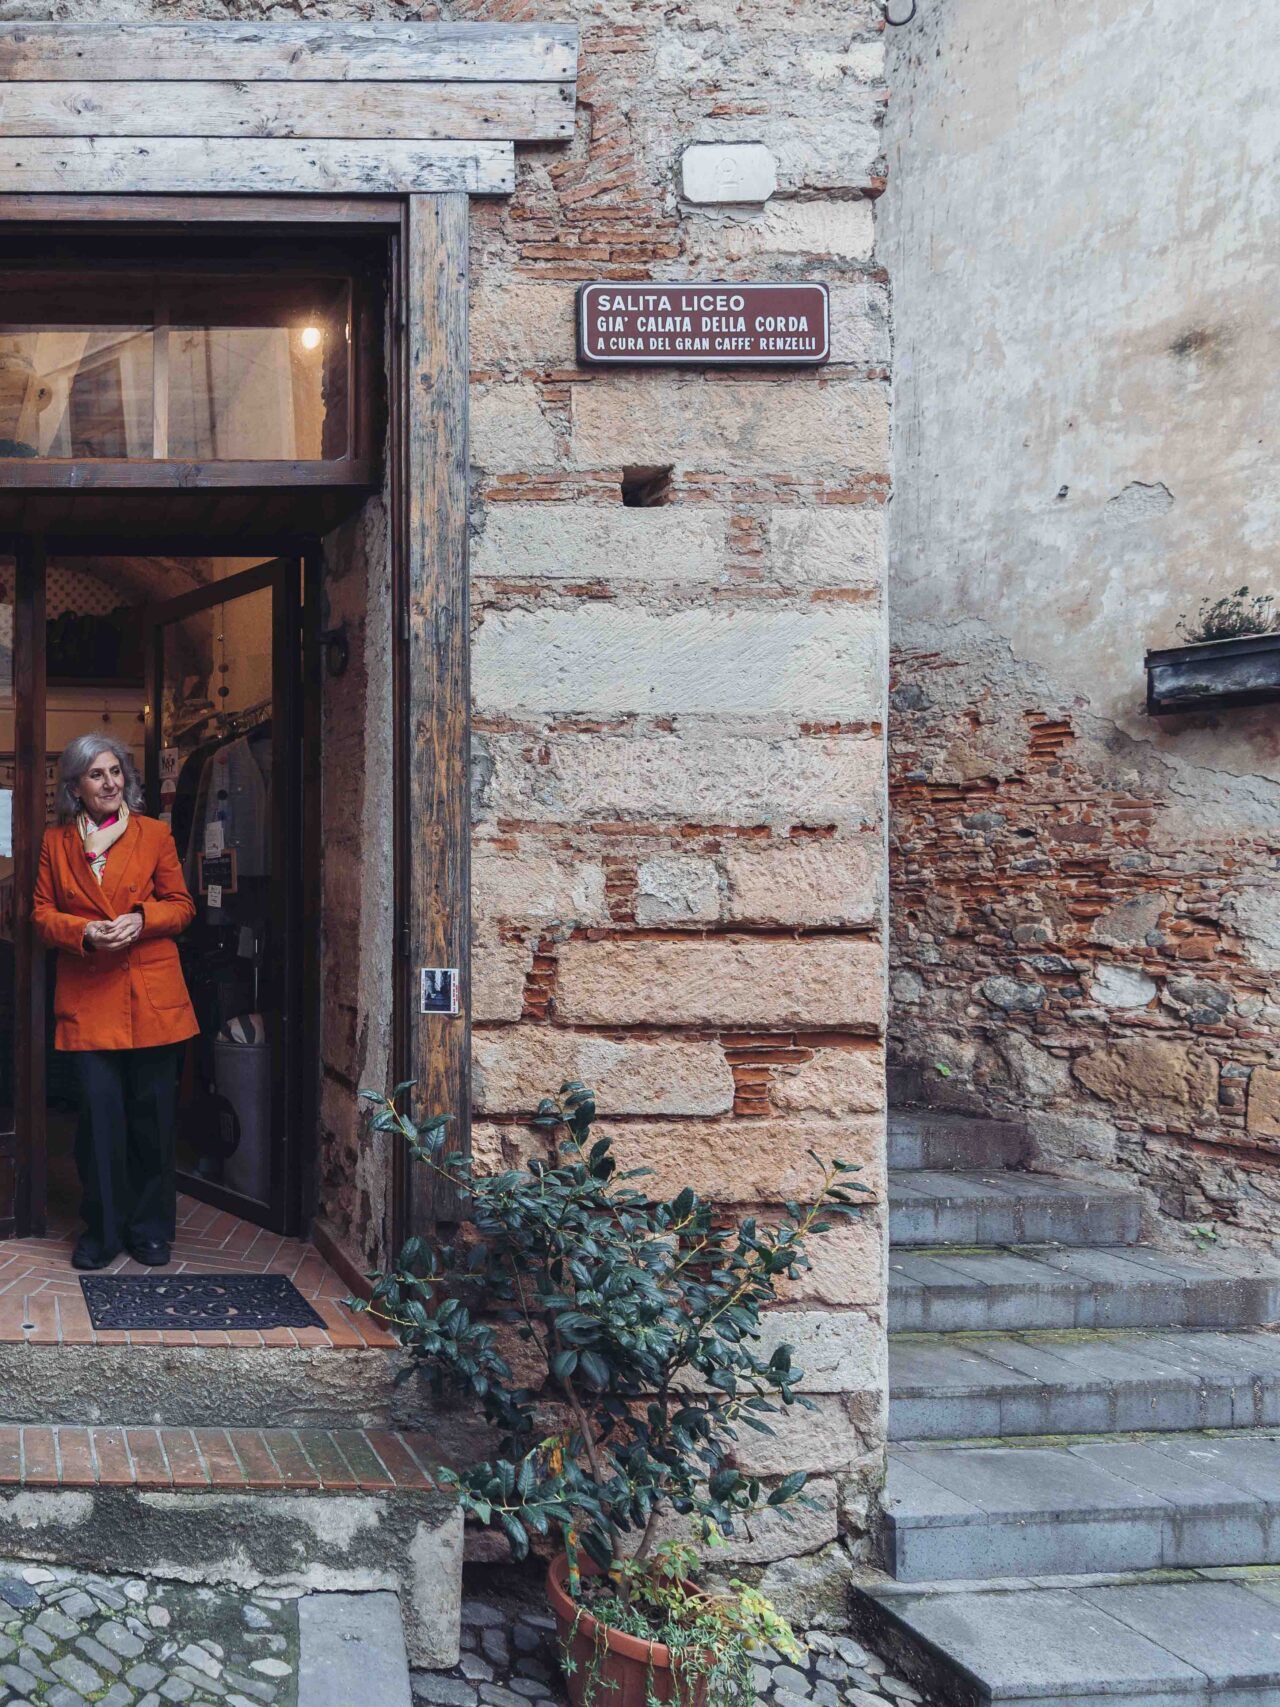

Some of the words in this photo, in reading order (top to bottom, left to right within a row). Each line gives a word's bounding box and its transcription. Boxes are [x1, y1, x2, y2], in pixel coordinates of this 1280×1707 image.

[597, 295, 672, 312] SALITA
[681, 295, 745, 312] LICEO
[597, 316, 629, 332] GIA'
[636, 316, 692, 332] CALATA
[701, 316, 746, 332] DELLA
[755, 316, 809, 332] CORDA
[597, 337, 605, 350] A
[610, 337, 644, 350] CURA
[649, 337, 671, 350] DEL
[675, 337, 710, 350] GRAN
[715, 337, 755, 350] CAFFE'
[759, 337, 816, 350] RENZELLI
